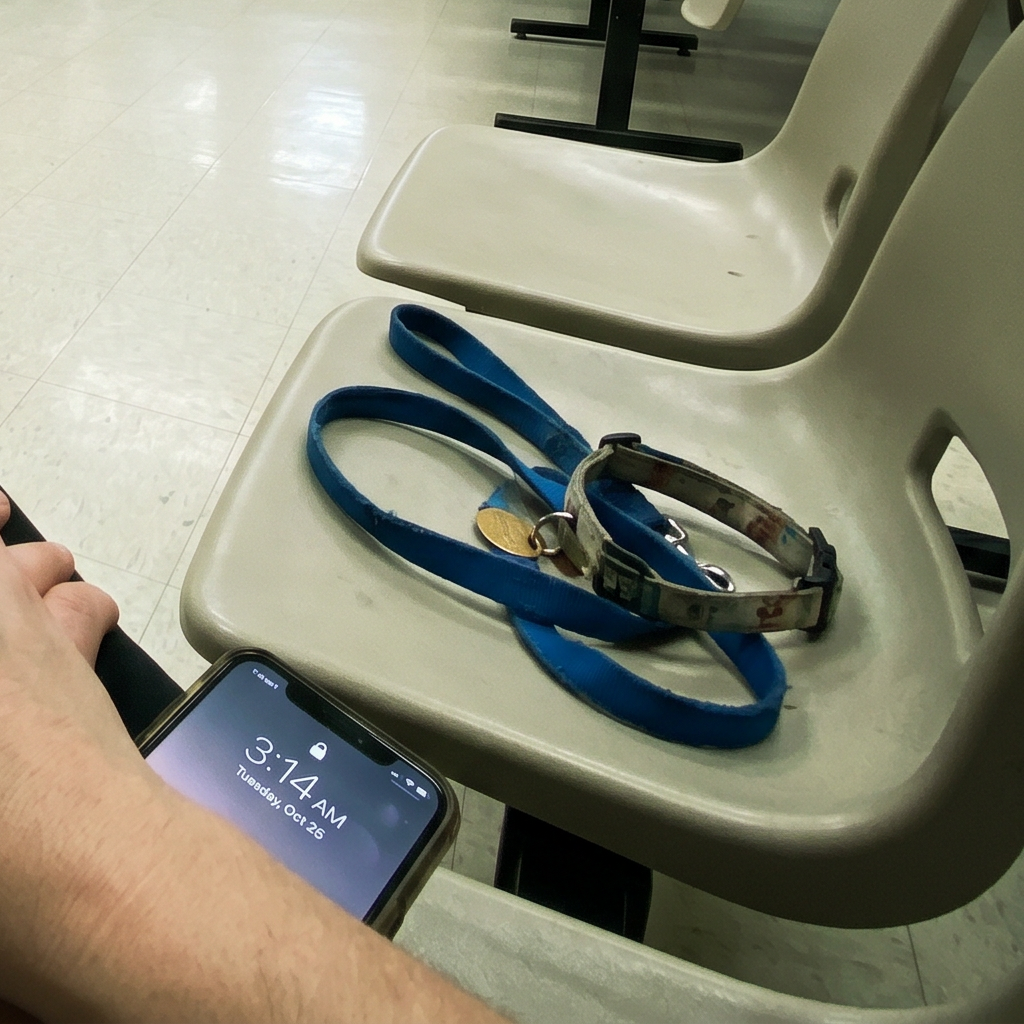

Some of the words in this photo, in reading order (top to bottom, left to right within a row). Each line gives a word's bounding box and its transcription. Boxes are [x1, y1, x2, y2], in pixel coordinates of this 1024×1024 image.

[236, 763, 282, 810] Tuesday,
[284, 804, 307, 827] Oct
[305, 821, 326, 840] 26
[245, 736, 319, 800] 3:14
[311, 798, 348, 829] AM
